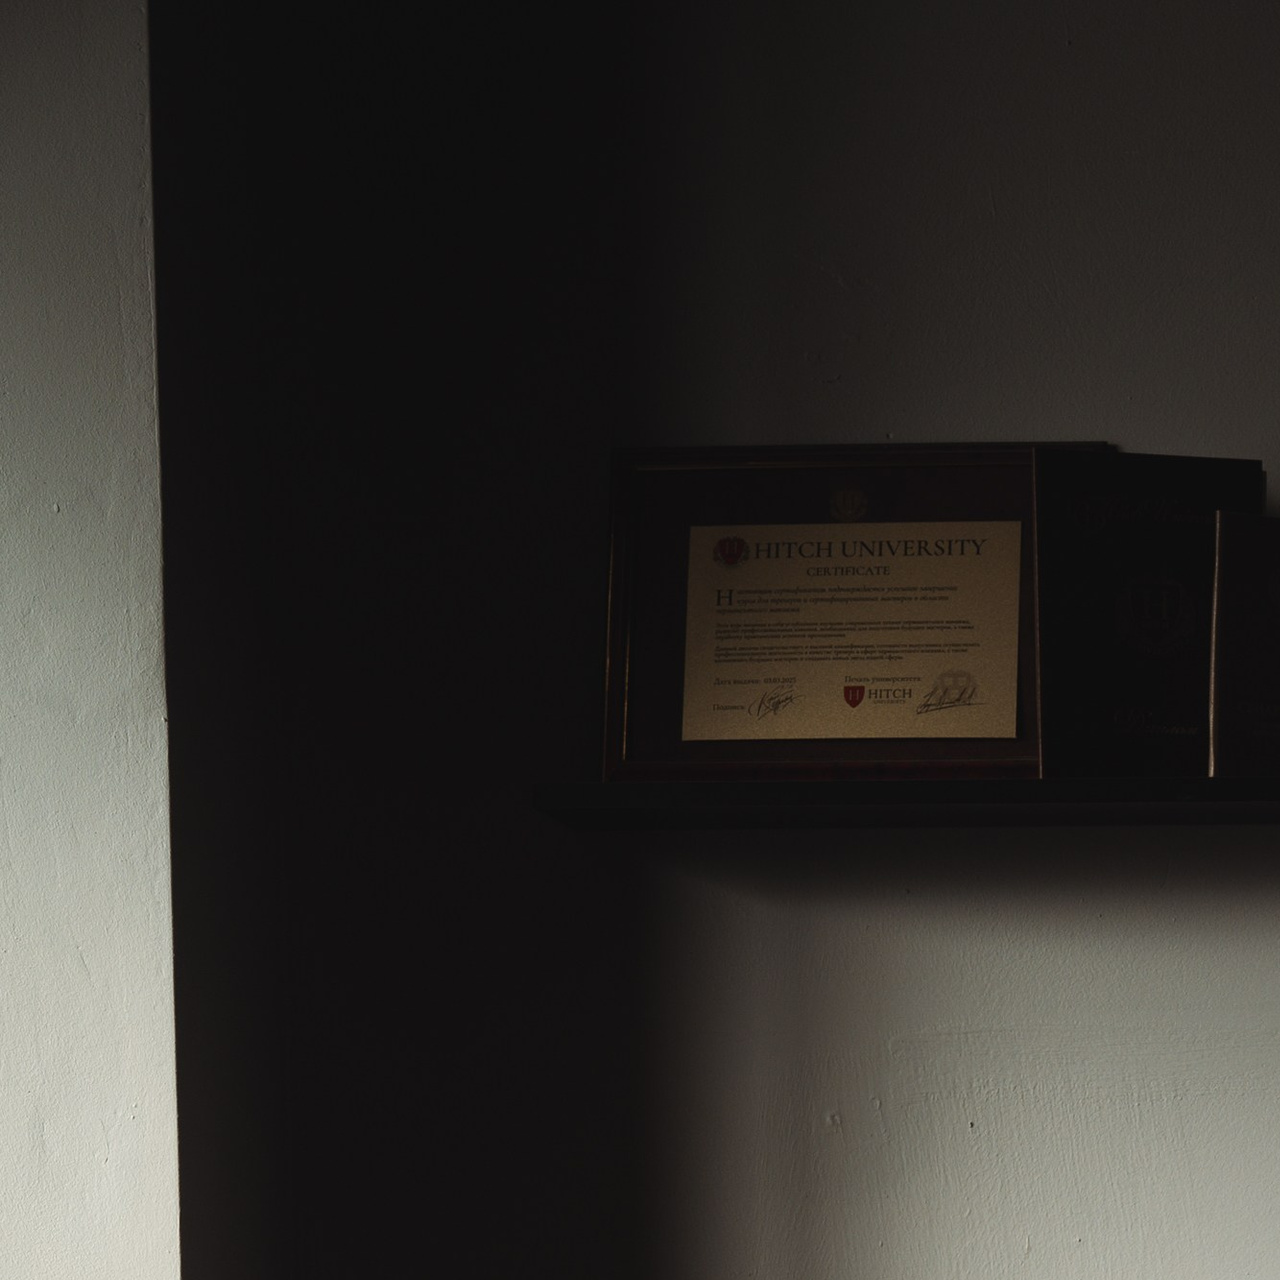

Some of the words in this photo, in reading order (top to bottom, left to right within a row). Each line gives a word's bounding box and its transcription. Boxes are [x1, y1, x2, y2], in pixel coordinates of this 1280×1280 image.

[755, 541, 832, 559] HITCH
[841, 538, 987, 558] UNIVERSITY
[806, 565, 890, 577] CERTIFICATE
[868, 688, 913, 699] HITCH
